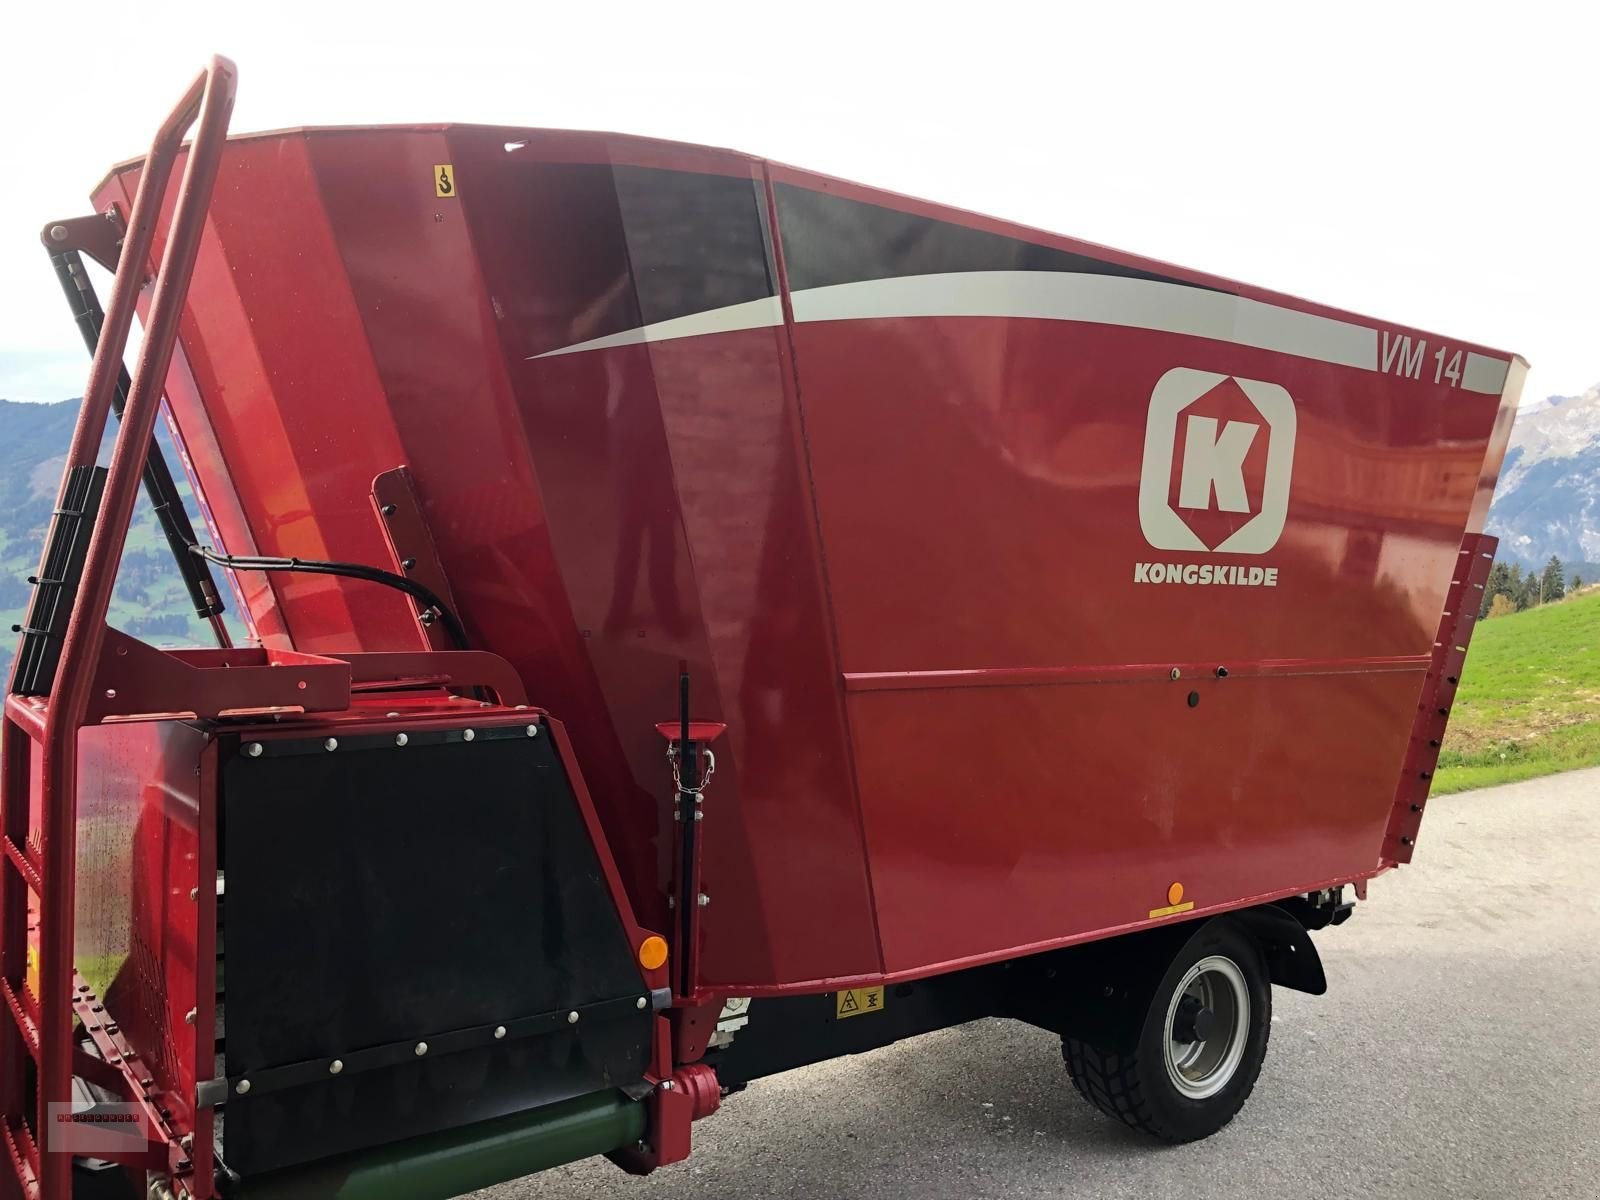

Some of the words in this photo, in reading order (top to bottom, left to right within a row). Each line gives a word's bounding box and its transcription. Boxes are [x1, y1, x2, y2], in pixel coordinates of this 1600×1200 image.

[1381, 330, 1427, 380] VM
[1434, 345, 1463, 388] 14
[1178, 414, 1260, 514] K
[1133, 562, 1279, 587] KONGSKILDE
